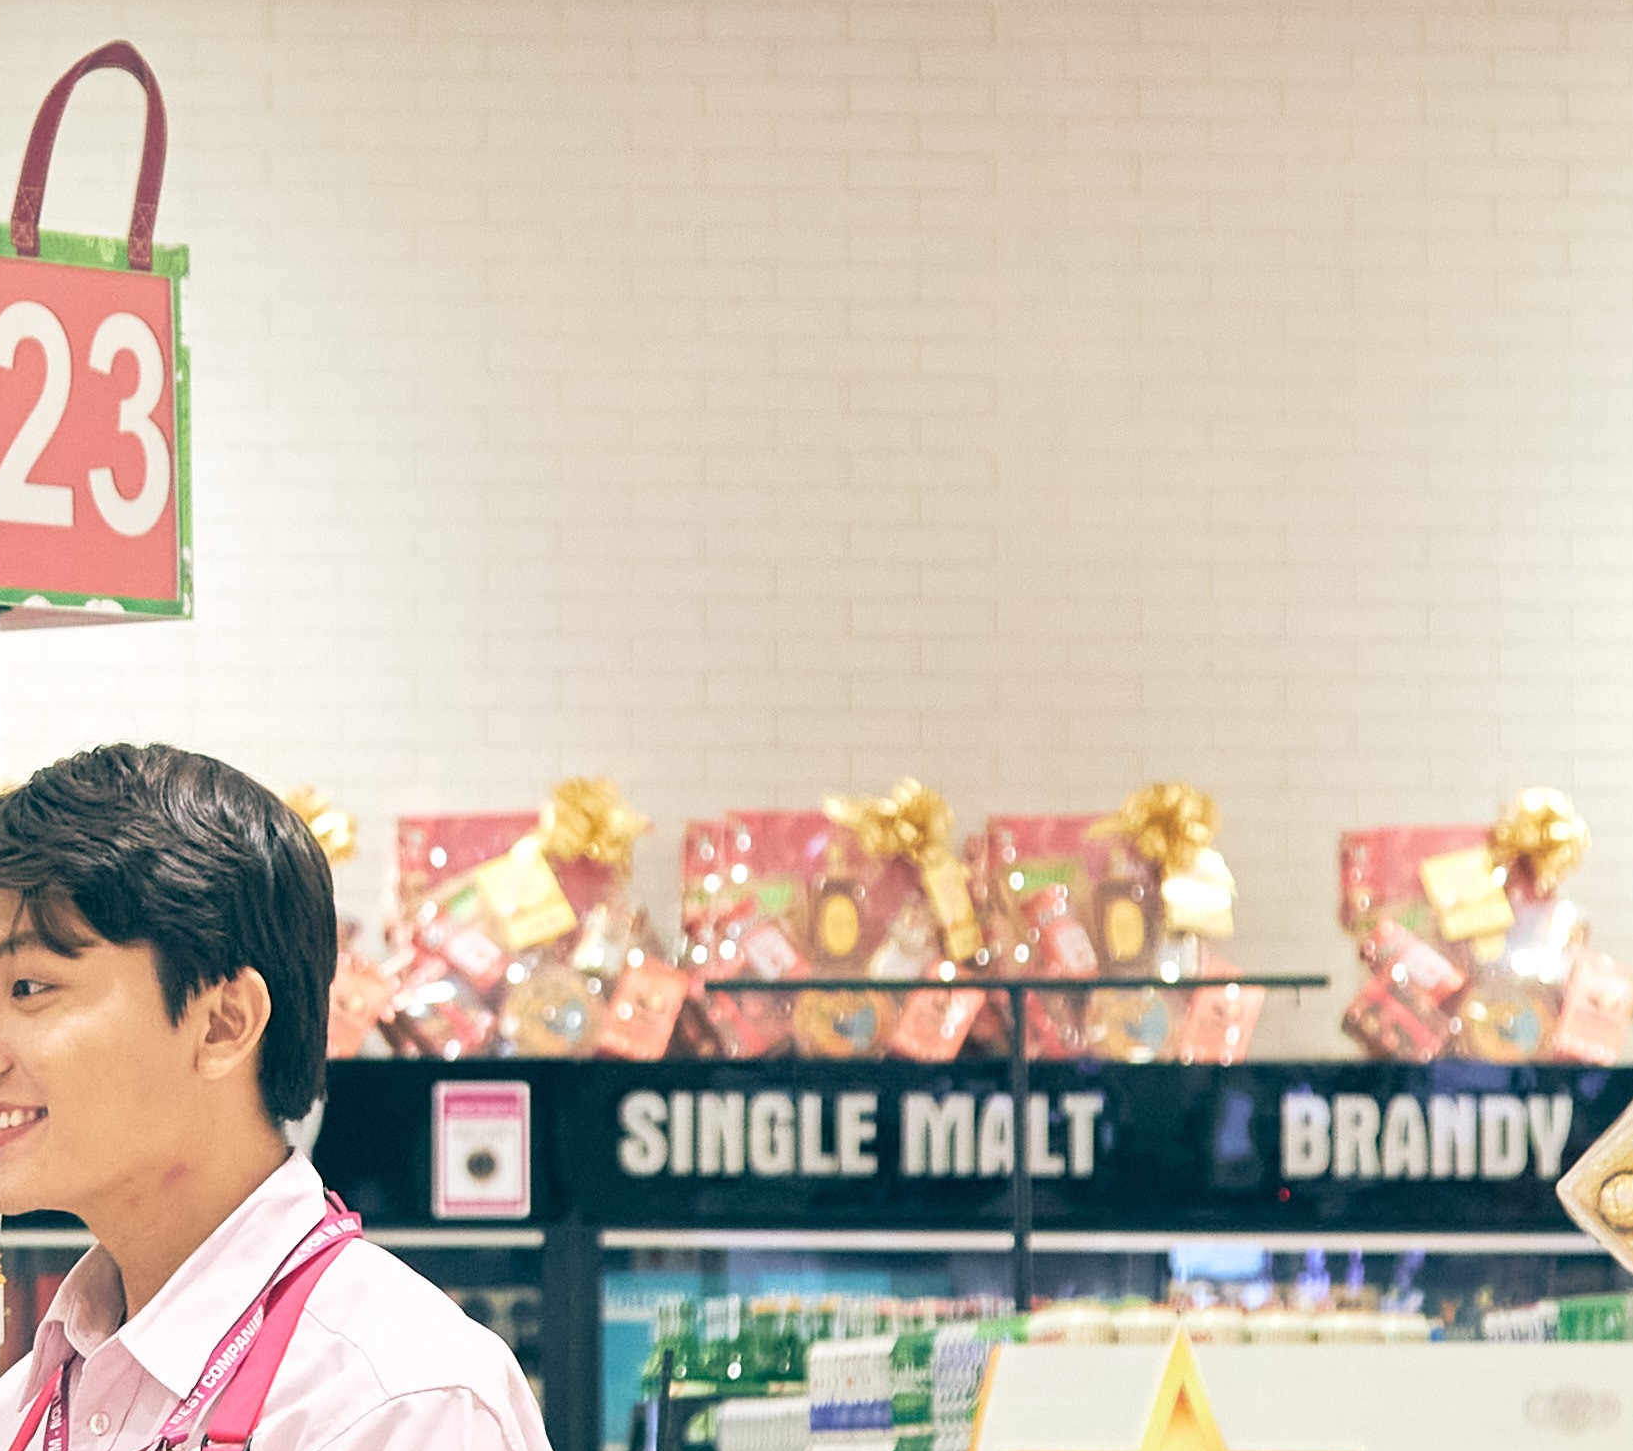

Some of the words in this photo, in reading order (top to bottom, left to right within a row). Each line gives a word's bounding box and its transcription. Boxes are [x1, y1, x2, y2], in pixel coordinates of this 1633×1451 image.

[618, 1090, 878, 1177] SINGLE
[902, 1092, 1105, 1178] MALT
[1279, 1093, 1575, 1180] BRANDY
[169, 1386, 206, 1427] BEST
